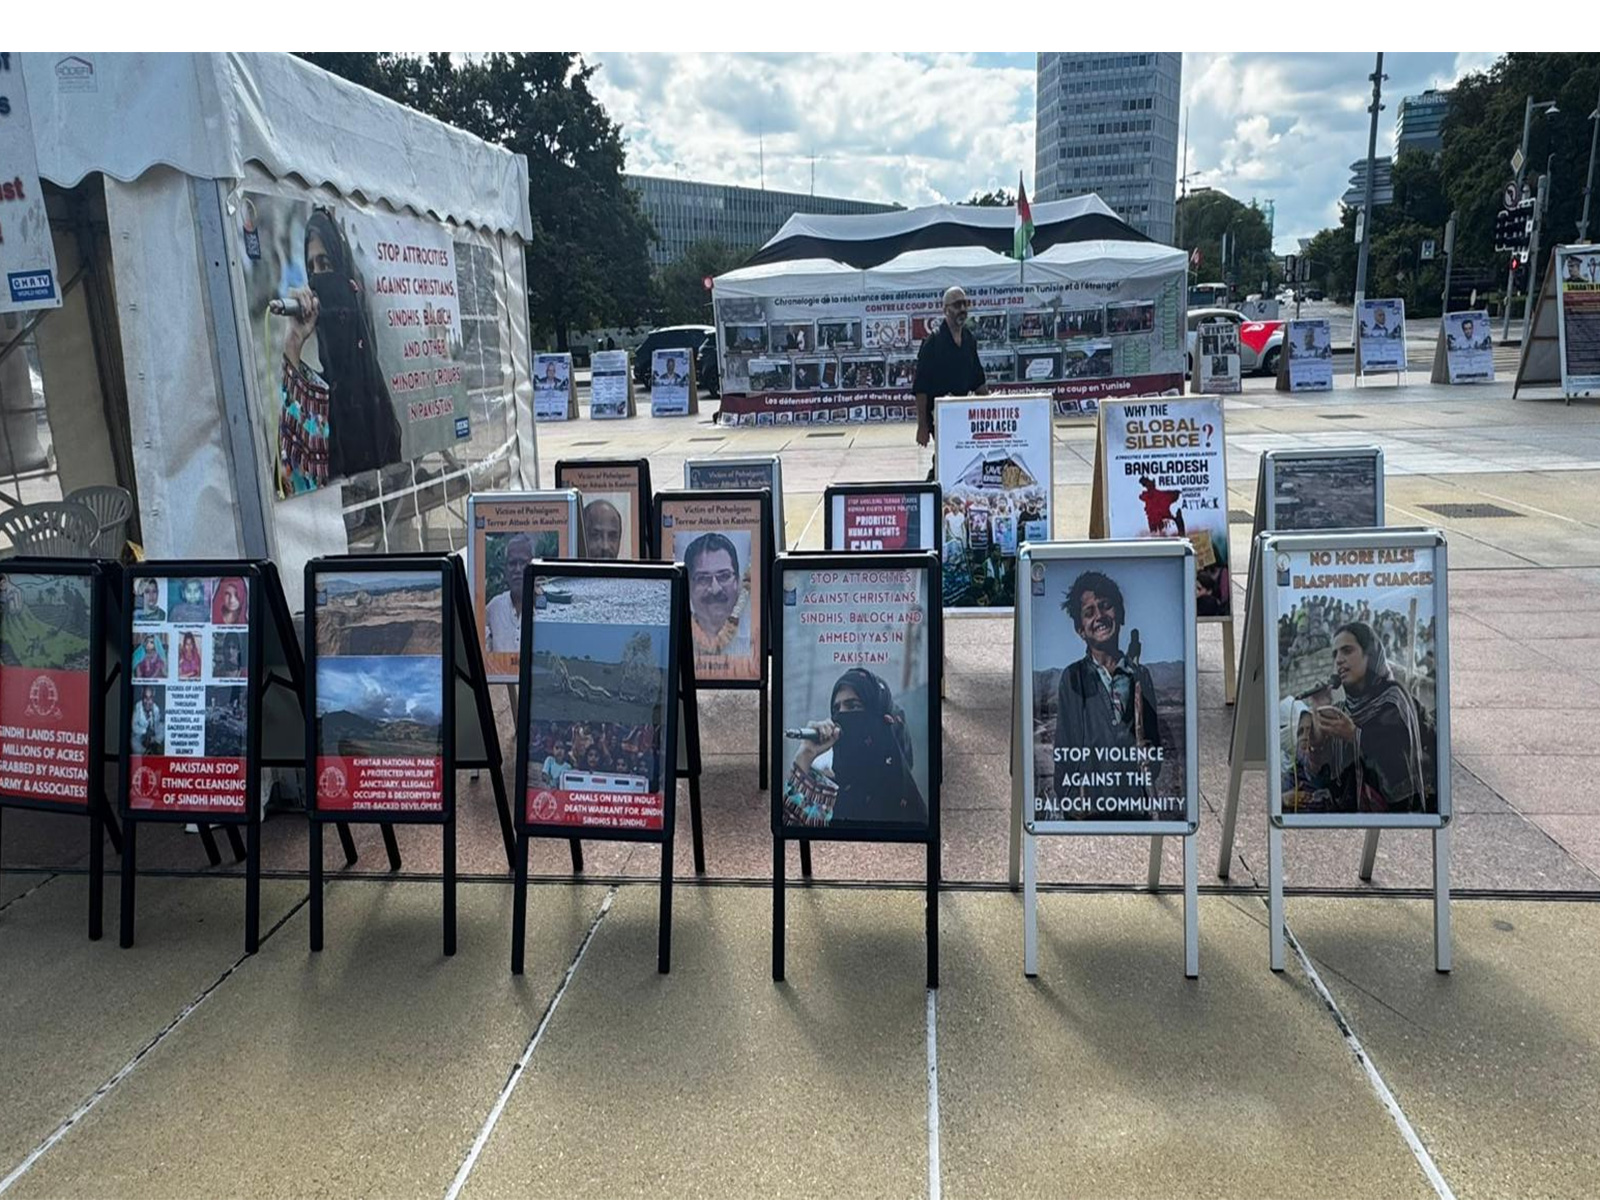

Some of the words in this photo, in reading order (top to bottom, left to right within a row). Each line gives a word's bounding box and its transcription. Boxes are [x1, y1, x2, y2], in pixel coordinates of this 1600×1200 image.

[377, 243, 400, 262] STOP
[403, 246, 448, 266] ATTROCITIES
[377, 276, 410, 294] AGAINST
[423, 307, 453, 326] BALOCH
[404, 341, 420, 358] AND
[968, 407, 1020, 420] MINORITIES
[1124, 405, 1147, 418] WHY
[1150, 404, 1168, 416] THE
[971, 420, 1017, 433] DISPLACED
[1126, 418, 1200, 434] GLOBAL
[1126, 433, 1200, 450] SILENCE
[1124, 460, 1208, 475] BANGLADESH
[1158, 474, 1209, 487] RELIGIOUS
[1181, 497, 1219, 510] ATTACK
[855, 514, 897, 526] PRIORITIZE
[848, 527, 873, 537] HUMAN
[874, 526, 900, 537] RIGHTS
[1310, 551, 1332, 566] NO
[1335, 550, 1374, 565] MORE
[1378, 548, 1415, 564] FALSE
[810, 572, 839, 584] STOP
[843, 571, 911, 583] ATTROCITIES
[1293, 573, 1370, 589] BLASPHEMY
[1373, 571, 1434, 587] CHARGES
[803, 592, 849, 604] AGAINST
[800, 612, 846, 624] SINDHIS,
[849, 612, 894, 623] BALOCH
[898, 611, 922, 623] AND
[818, 632, 888, 643] AHMEDIYYAS
[891, 632, 903, 642] IN
[833, 652, 889, 663] PAKISTAN!
[26, 728, 55, 742] LANDS
[56, 731, 88, 745] STOLEN
[2, 743, 42, 757] MILLIONS
[43, 747, 55, 758] OF
[56, 749, 85, 762] ACRES
[1053, 747, 1091, 762] STOP
[1094, 746, 1164, 761] VIOLENCE
[169, 762, 213, 773] PAKISTAN
[216, 763, 240, 774] STOP
[382, 758, 416, 766] NATIONAL
[417, 758, 435, 766] PARK
[36, 763, 48, 775] BY
[0, 777, 23, 790] ARMY
[24, 780, 31, 791] &
[161, 778, 193, 789] ETHNIC
[194, 779, 247, 791] CLEANSING
[401, 780, 435, 788] ILLEGALLY
[1062, 772, 1123, 787] AGAINST
[1126, 772, 1152, 786] THE
[163, 793, 176, 804] OF
[177, 794, 209, 805] SINDHI
[210, 795, 244, 806] HINDUS
[353, 791, 387, 799] OCCUPIED
[387, 791, 393, 799] &
[432, 791, 441, 799] BY
[569, 793, 598, 802] CANALS
[600, 794, 611, 803] ON
[612, 795, 633, 803] RIVER
[634, 796, 656, 804] INDUS
[564, 804, 587, 813] DEATH
[588, 805, 624, 814] WARRANT
[624, 806, 639, 815] FOR
[1034, 797, 1092, 812] BALOCH
[1096, 796, 1185, 812] COMMUNITY
[583, 816, 611, 826] SINDHIS
[612, 817, 618, 826] &
[620, 818, 647, 827] SINDHU
